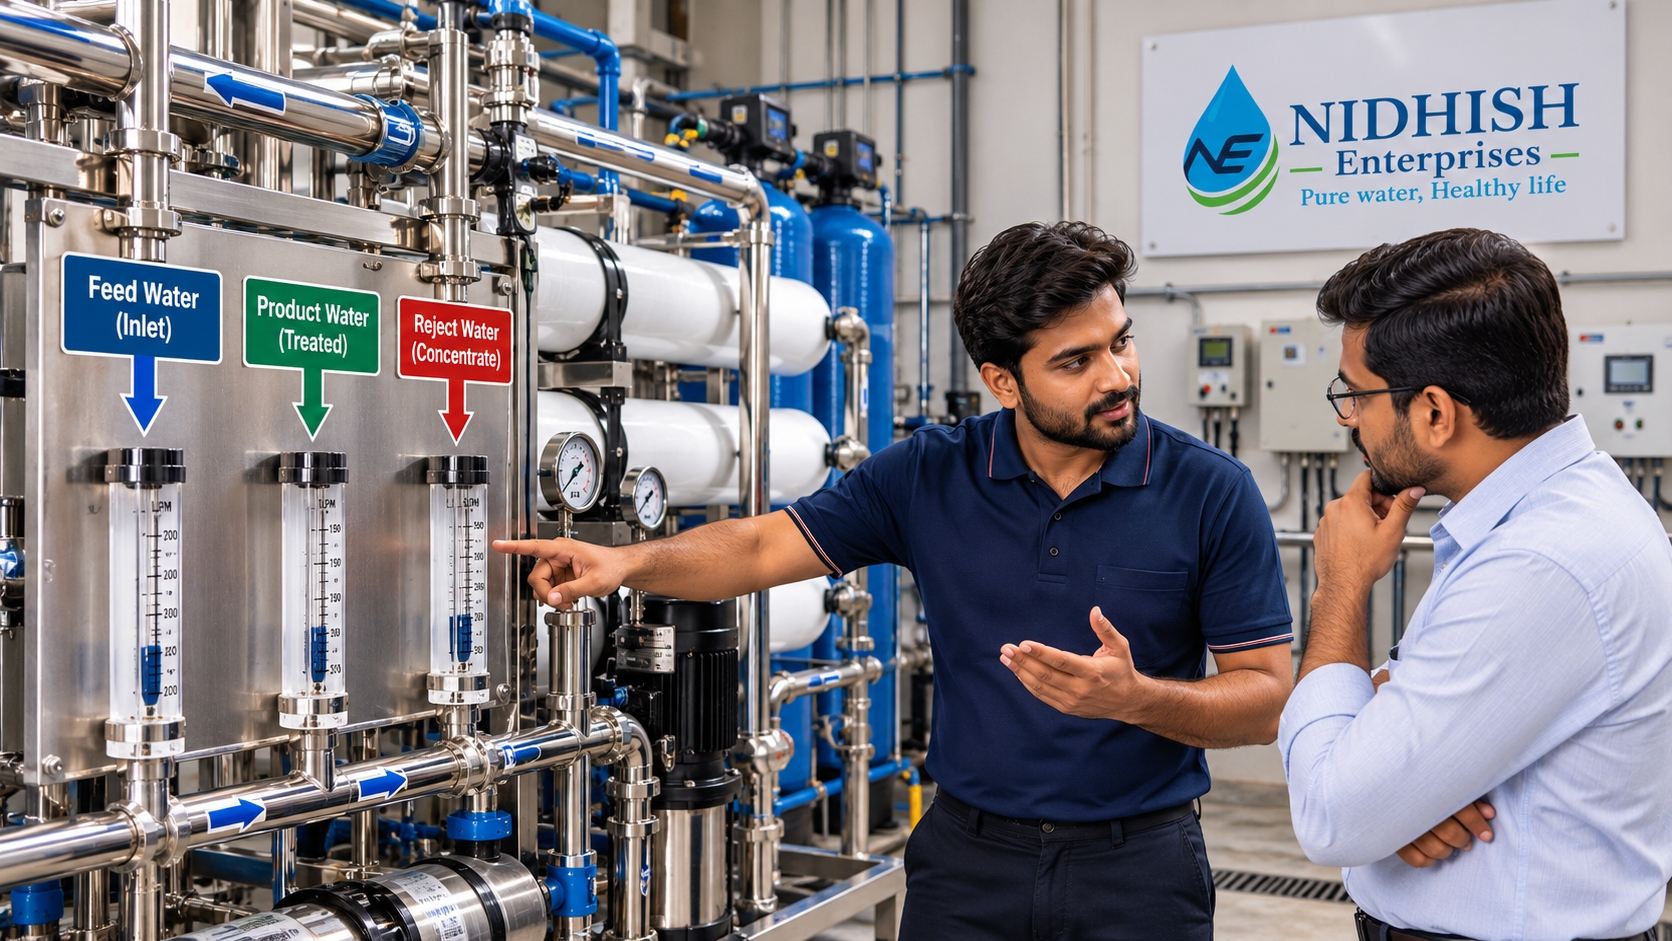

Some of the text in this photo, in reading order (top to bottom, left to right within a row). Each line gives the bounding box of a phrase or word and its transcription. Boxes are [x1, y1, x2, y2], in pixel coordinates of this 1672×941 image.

[1289, 82, 1580, 147] NIDHISH
[1335, 140, 1541, 179] Enterprises
[1301, 174, 1568, 207] Pure water, Healthy life
[88, 274, 200, 309] Feed Water
[115, 310, 172, 344] (Inlet)
[257, 295, 370, 328] Product Water
[413, 313, 500, 341] Reject Water
[278, 327, 348, 359] (Treated)
[411, 338, 502, 372] (Concentrate)
[163, 530, 178, 541] 200
[163, 569, 178, 580] 200
